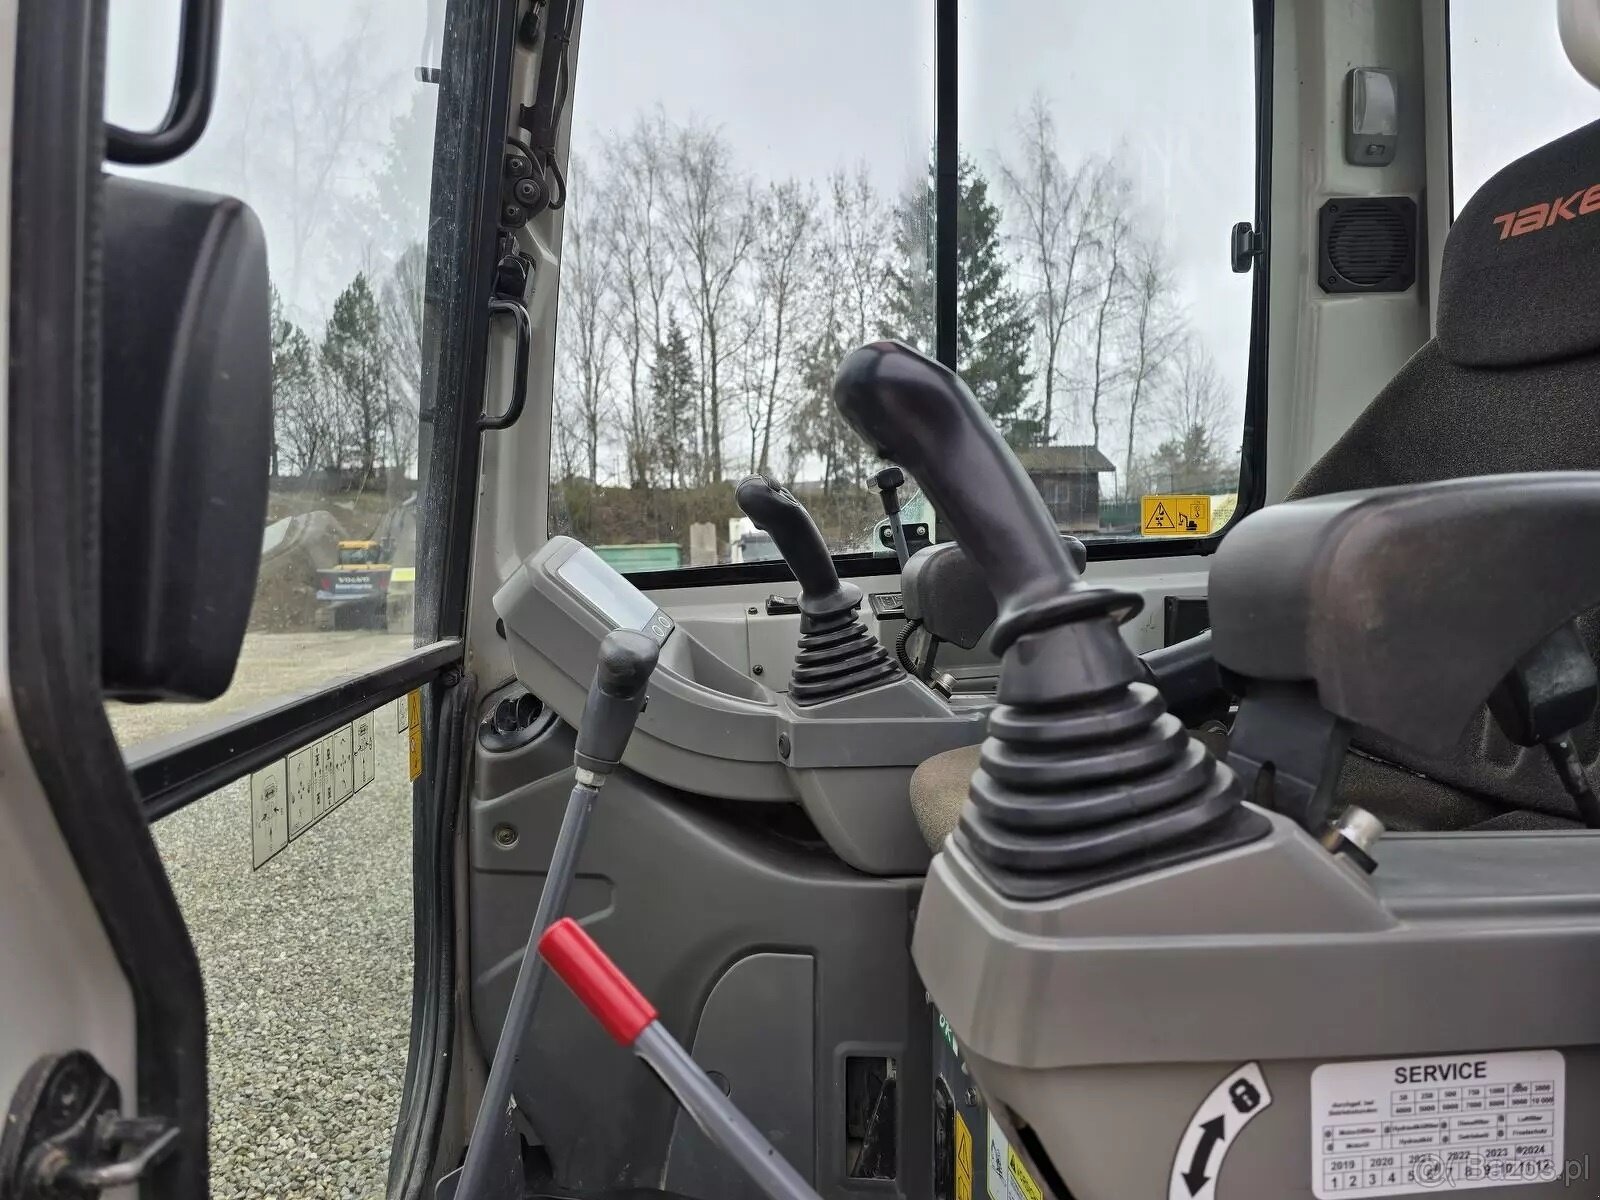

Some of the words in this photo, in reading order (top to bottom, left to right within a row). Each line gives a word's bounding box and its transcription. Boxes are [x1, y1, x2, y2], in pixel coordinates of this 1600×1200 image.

[1394, 1061, 1488, 1085] SERVICE
[1331, 1160, 1356, 1171] 2019
[1369, 1157, 1395, 1168] 2020
[1485, 1148, 1508, 1158] 2023
[1522, 1144, 1545, 1155] 2024
[1331, 1176, 1338, 1189] 1
[1349, 1175, 1358, 1187] 2
[1368, 1173, 1377, 1185] 3
[1387, 1172, 1396, 1183] 4
